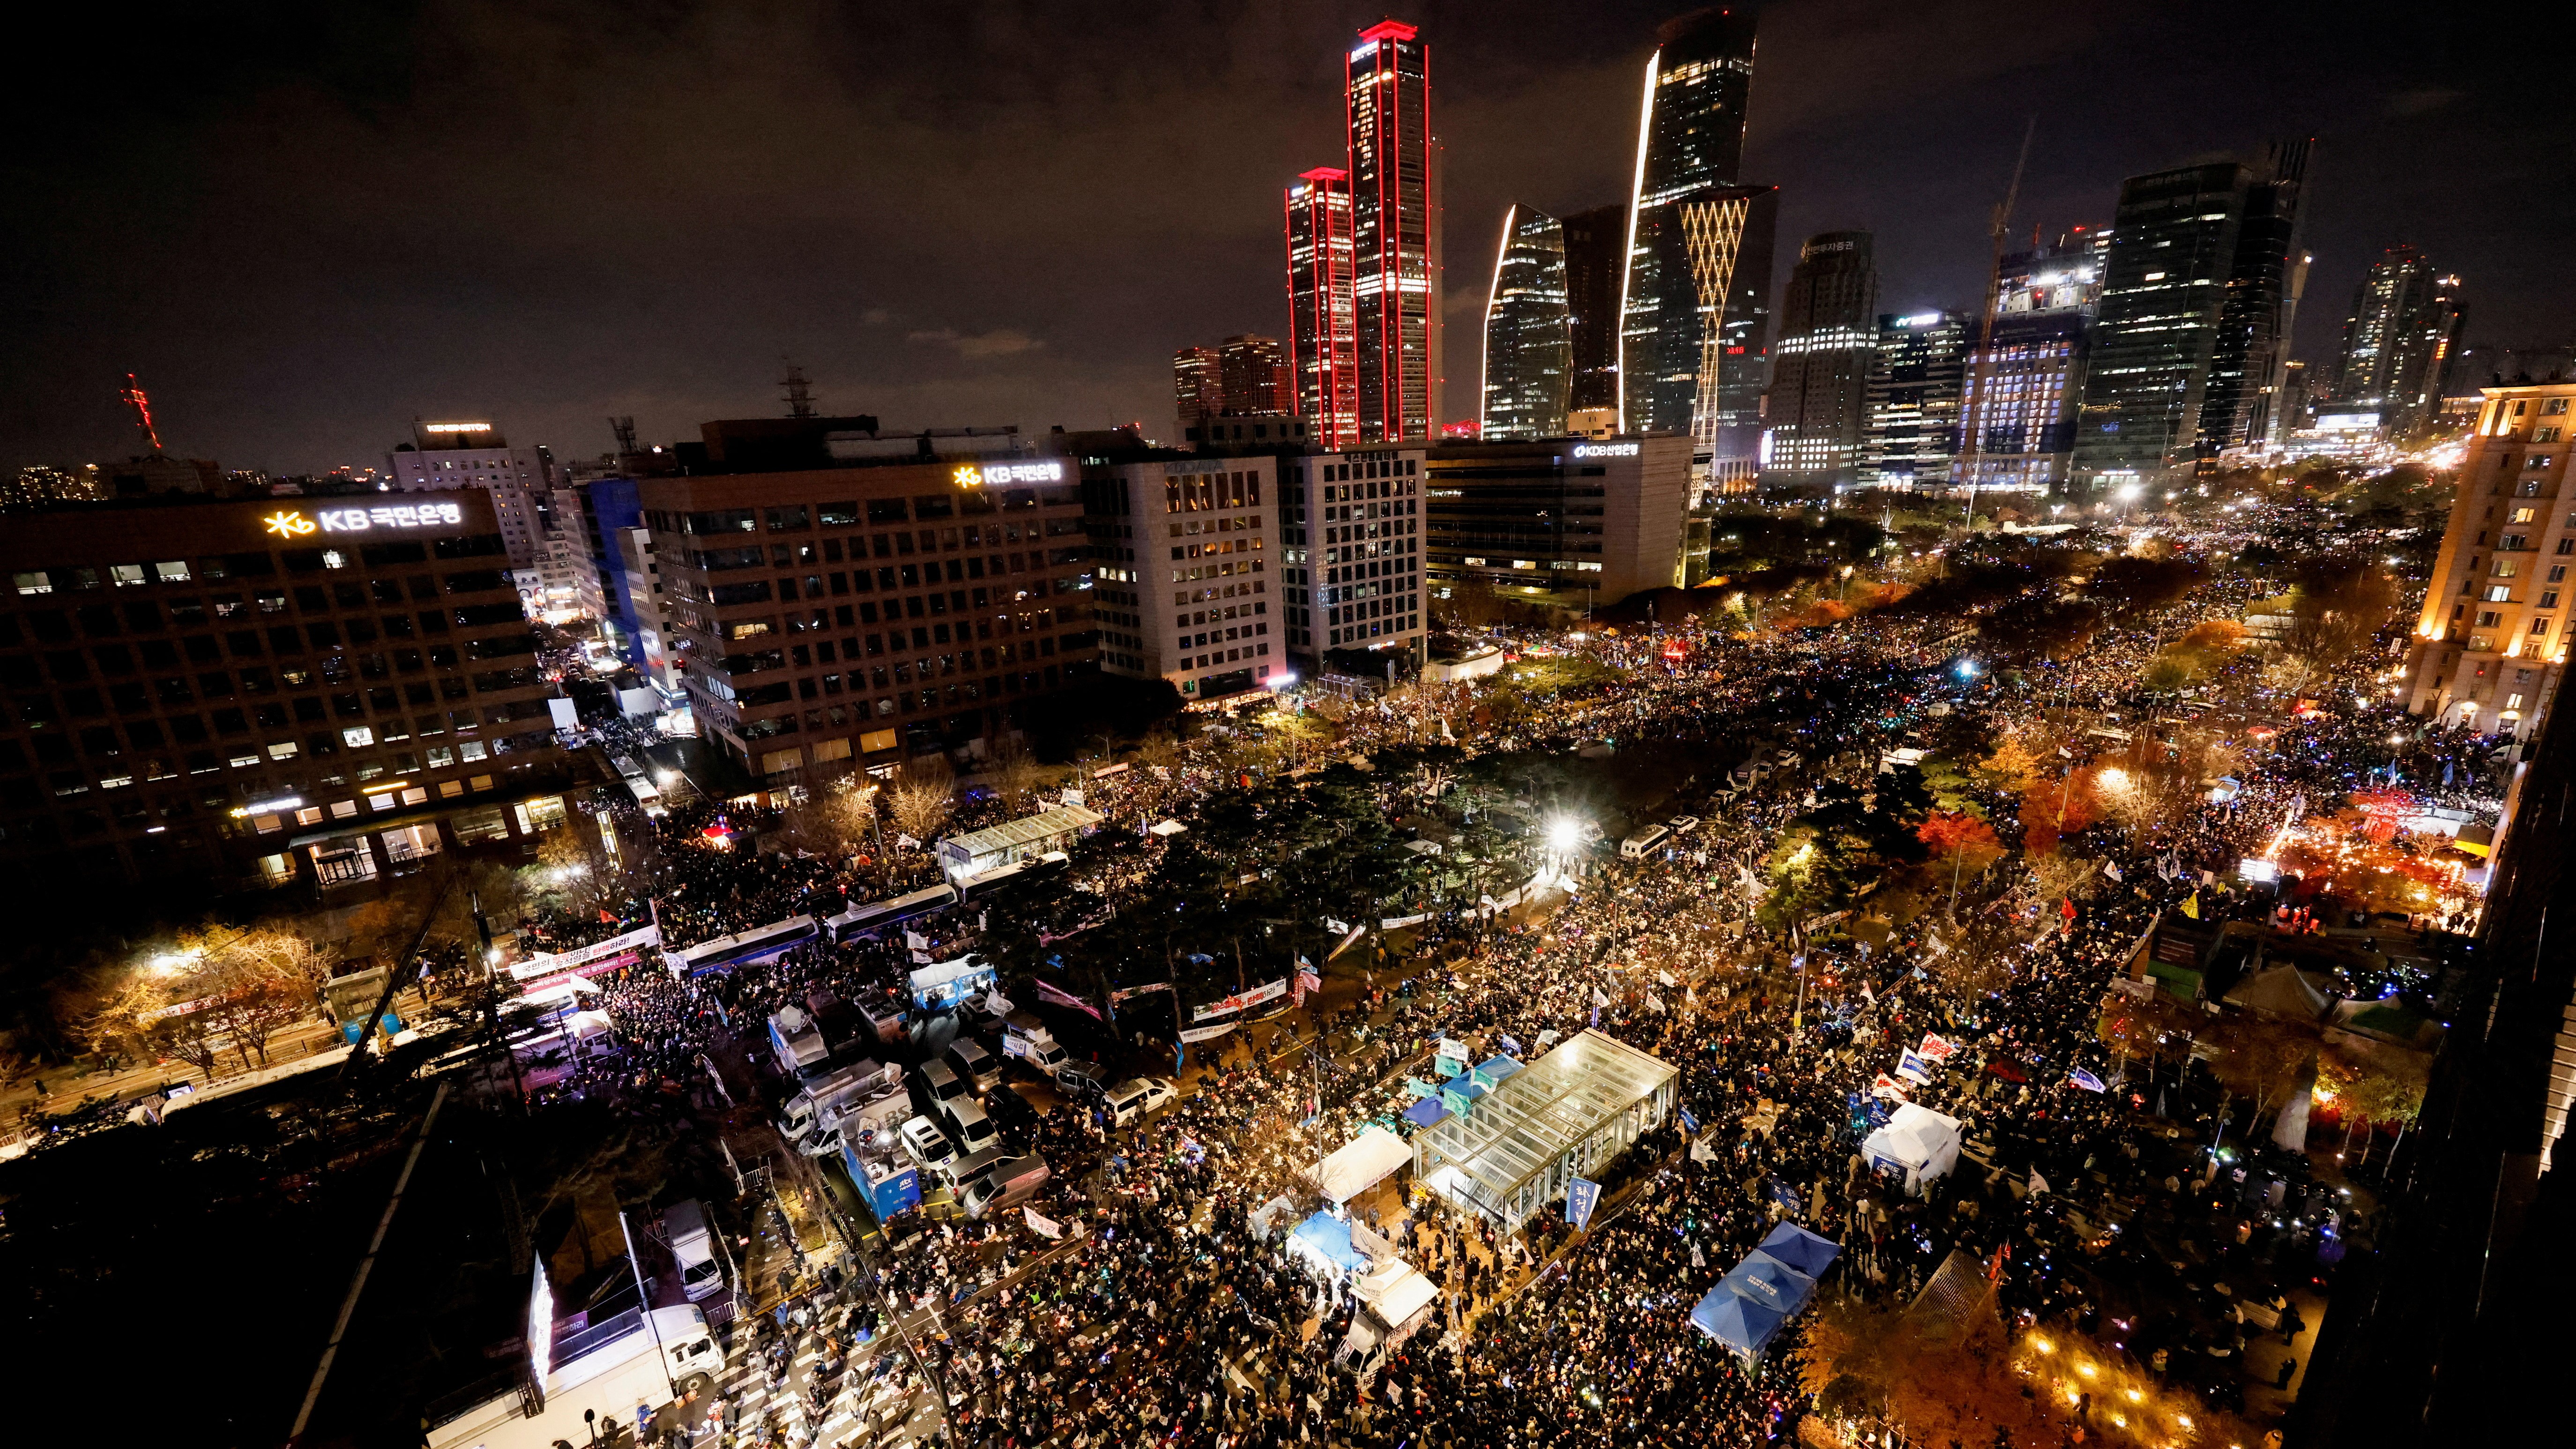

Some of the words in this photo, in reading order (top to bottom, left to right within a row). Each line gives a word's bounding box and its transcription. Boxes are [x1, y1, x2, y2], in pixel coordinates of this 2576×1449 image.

[427, 424, 491, 432] KENSINGTON
[1586, 444, 1638, 456] KDB산업은행
[984, 463, 1061, 484] KB국민은행
[320, 504, 462, 532] KB국민은행
[593, 937, 630, 956] 탄핵하라!
[522, 959, 550, 973] 국민의
[577, 966, 590, 976] 즉각
[591, 960, 618, 973] 중단하라!
[1247, 987, 1275, 1006] 탄핵하라
[1905, 1058, 1931, 1075] 조국혁신당
[884, 1104, 911, 1127] BS
[899, 1177, 912, 1188] jtbc
[899, 1183, 913, 1192] news
[1389, 1320, 1411, 1340] 한동훈은
